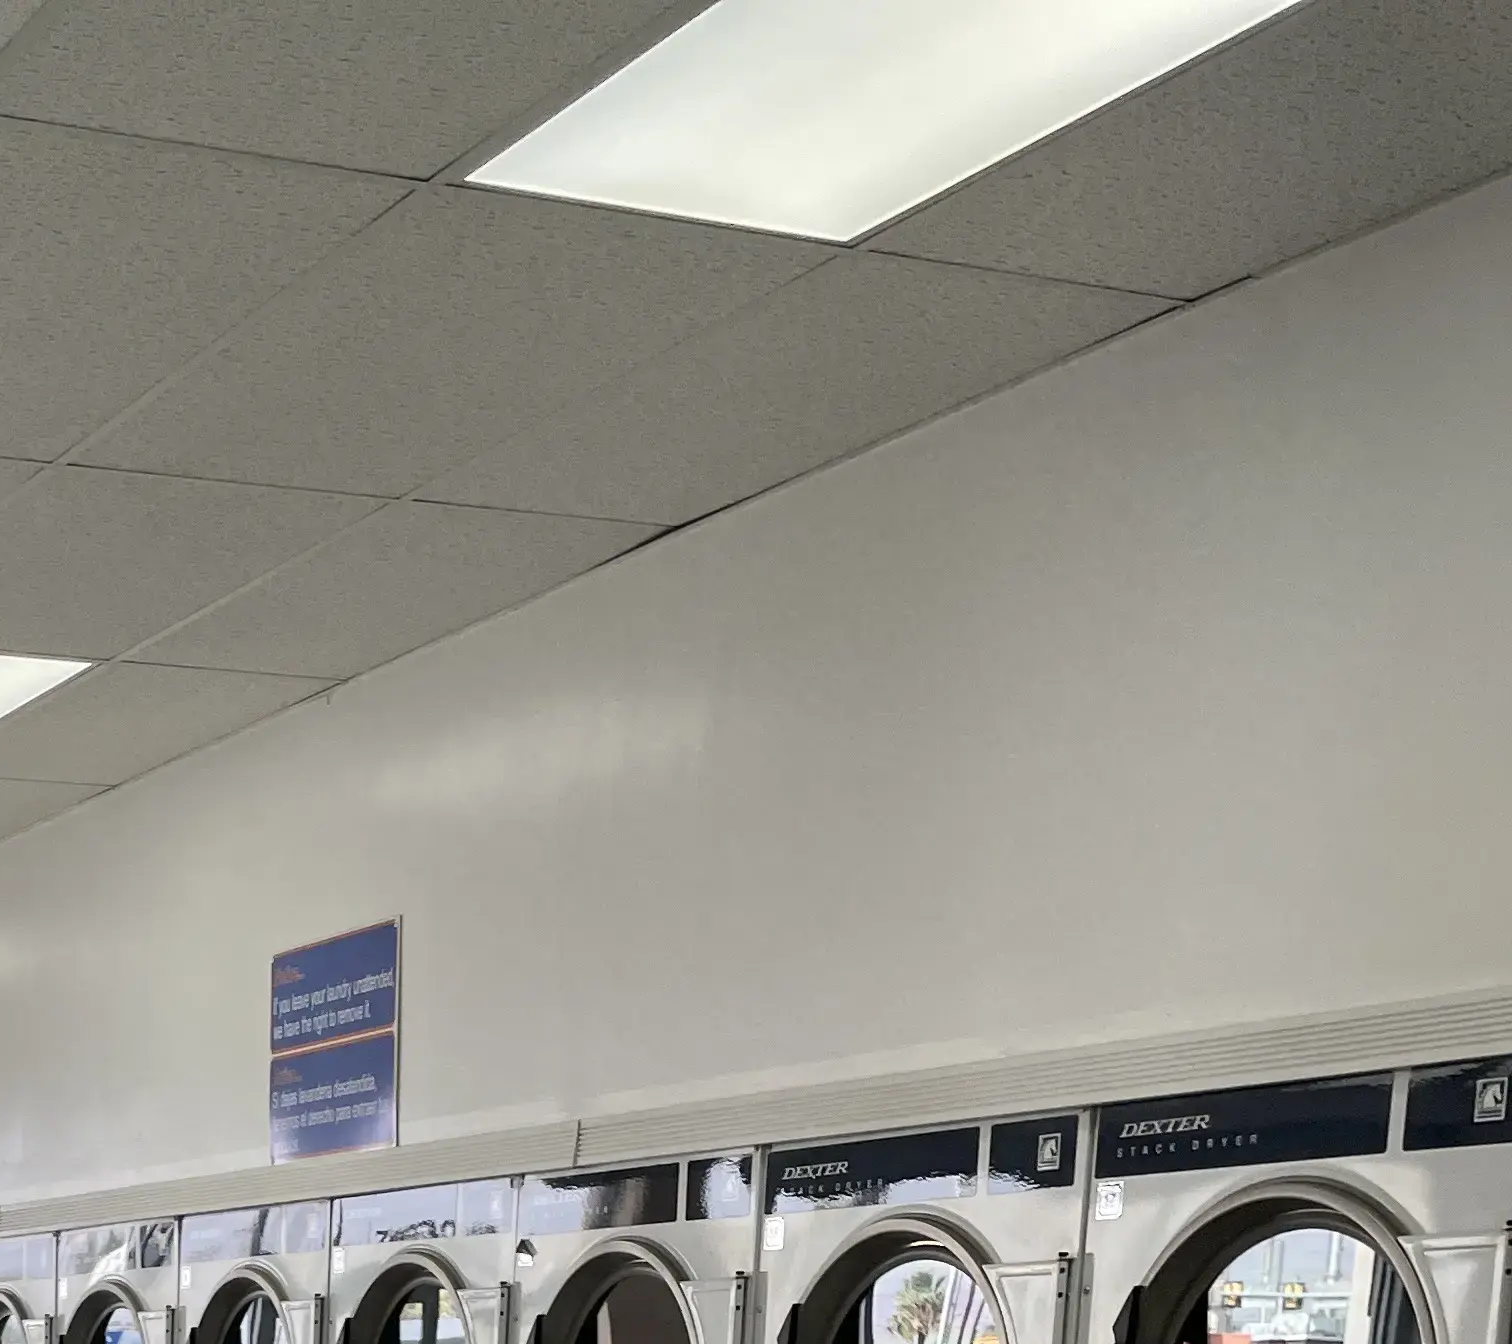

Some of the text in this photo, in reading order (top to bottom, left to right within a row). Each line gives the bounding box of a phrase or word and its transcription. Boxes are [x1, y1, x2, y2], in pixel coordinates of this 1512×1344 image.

[326, 978, 353, 1002] laundry
[1119, 1114, 1211, 1139] DEXTER
[1116, 1133, 1259, 1159] STACK DRYER
[781, 1160, 849, 1181] DEXTER
[834, 1178, 884, 1192] DRYER
